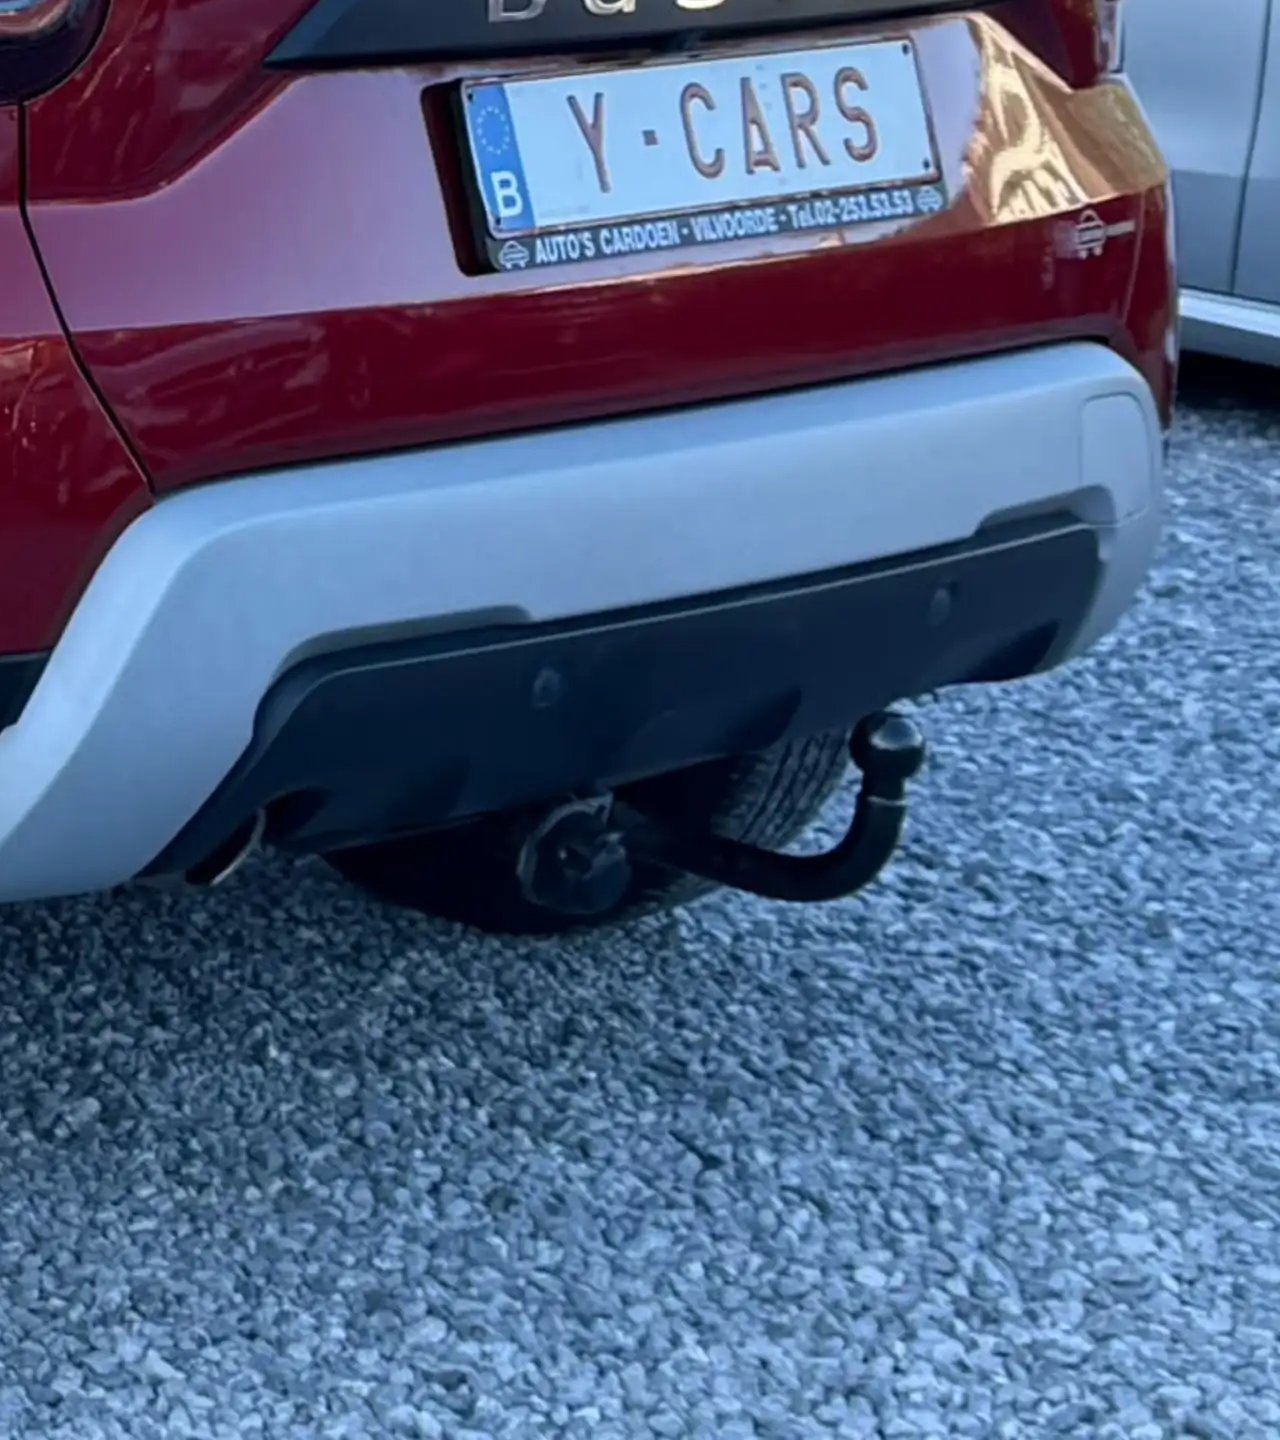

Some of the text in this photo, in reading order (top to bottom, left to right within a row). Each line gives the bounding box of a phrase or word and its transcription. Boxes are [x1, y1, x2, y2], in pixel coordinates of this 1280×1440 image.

[490, 170, 523, 218] B
[535, 231, 596, 264] AUTO'S
[599, 219, 681, 256] CARDOEN
[690, 208, 779, 242] VILVOORDE
